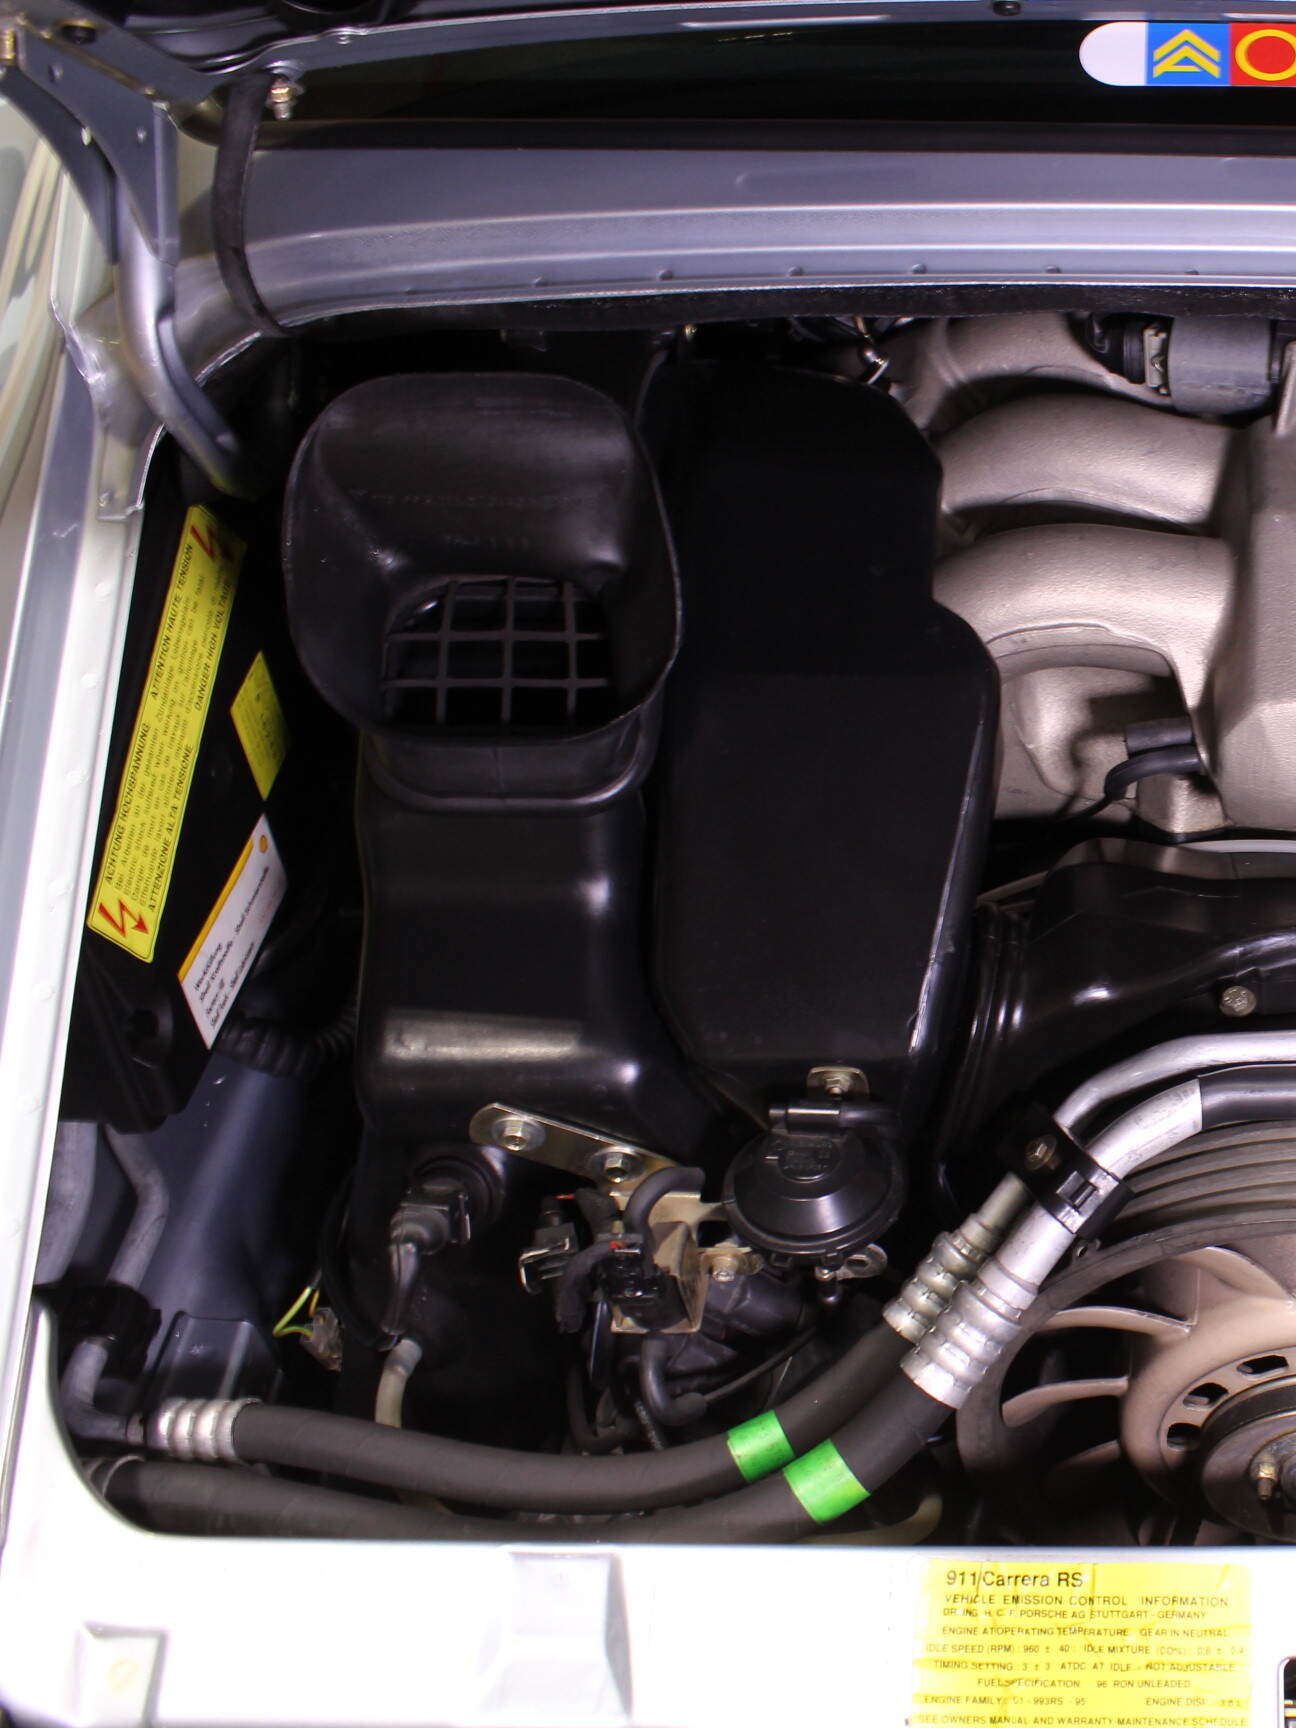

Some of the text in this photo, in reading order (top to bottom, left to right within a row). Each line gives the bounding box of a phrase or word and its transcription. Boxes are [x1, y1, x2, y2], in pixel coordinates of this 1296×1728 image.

[149, 633, 171, 700] ATTENTION
[166, 591, 181, 633] HAUTE
[176, 542, 193, 591] TENSION
[194, 661, 211, 712] DANGER
[205, 631, 217, 661] HIGH
[104, 823, 124, 884] ACHTUNG
[118, 721, 149, 823] HOCHSPANNUNG
[147, 835, 171, 911] ATTENZIONE
[165, 804, 178, 835] ALTA
[174, 744, 193, 800] TENSIONE
[983, 1571, 1049, 1587] Carrera
[1058, 1572, 1083, 1587] RS
[945, 1594, 1228, 1606] VEHICLE EMISSION CONTROL INFORMATION
[1020, 1610, 1067, 1618] PORSCHE
[1090, 1610, 1148, 1619] STUTTGART
[1157, 1610, 1206, 1619] GERMANY
[943, 1626, 978, 1635] ENGINE
[995, 1627, 1054, 1635] OPERATING
[1057, 1627, 1128, 1636] TEMPERATURE
[1140, 1628, 1167, 1637] GEAR
[1171, 1629, 1179, 1637] IN
[1184, 1629, 1227, 1637] NEUTRAL
[927, 1644, 947, 1652] IDLE
[952, 1644, 984, 1653] SPEED
[1084, 1644, 1103, 1653] IDLE
[1108, 1645, 1150, 1654] MIXTURE
[934, 1660, 968, 1669] TIMING
[971, 1662, 1013, 1671] SETTING
[1061, 1662, 1086, 1670] ATDC
[1110, 1663, 1131, 1671] IDLE
[1146, 1663, 1165, 1671] NOT
[1170, 1663, 1234, 1672] ADJUSTABLE
[978, 1679, 1080, 1688] FUEL SPECIFICATION
[1113, 1680, 1134, 1688] RON
[1138, 1680, 1191, 1688] UNLEADED
[925, 1696, 960, 1704] ENGINE
[966, 1696, 1001, 1704] FAMILY
[1146, 1698, 1182, 1706] ENGINE
[919, 1715, 937, 1723] SEE
[942, 1715, 986, 1724] OWNERS
[990, 1716, 1027, 1724] MANUAL
[1033, 1716, 1053, 1724] AND
[1192, 1717, 1245, 1726] SCHEDULE
